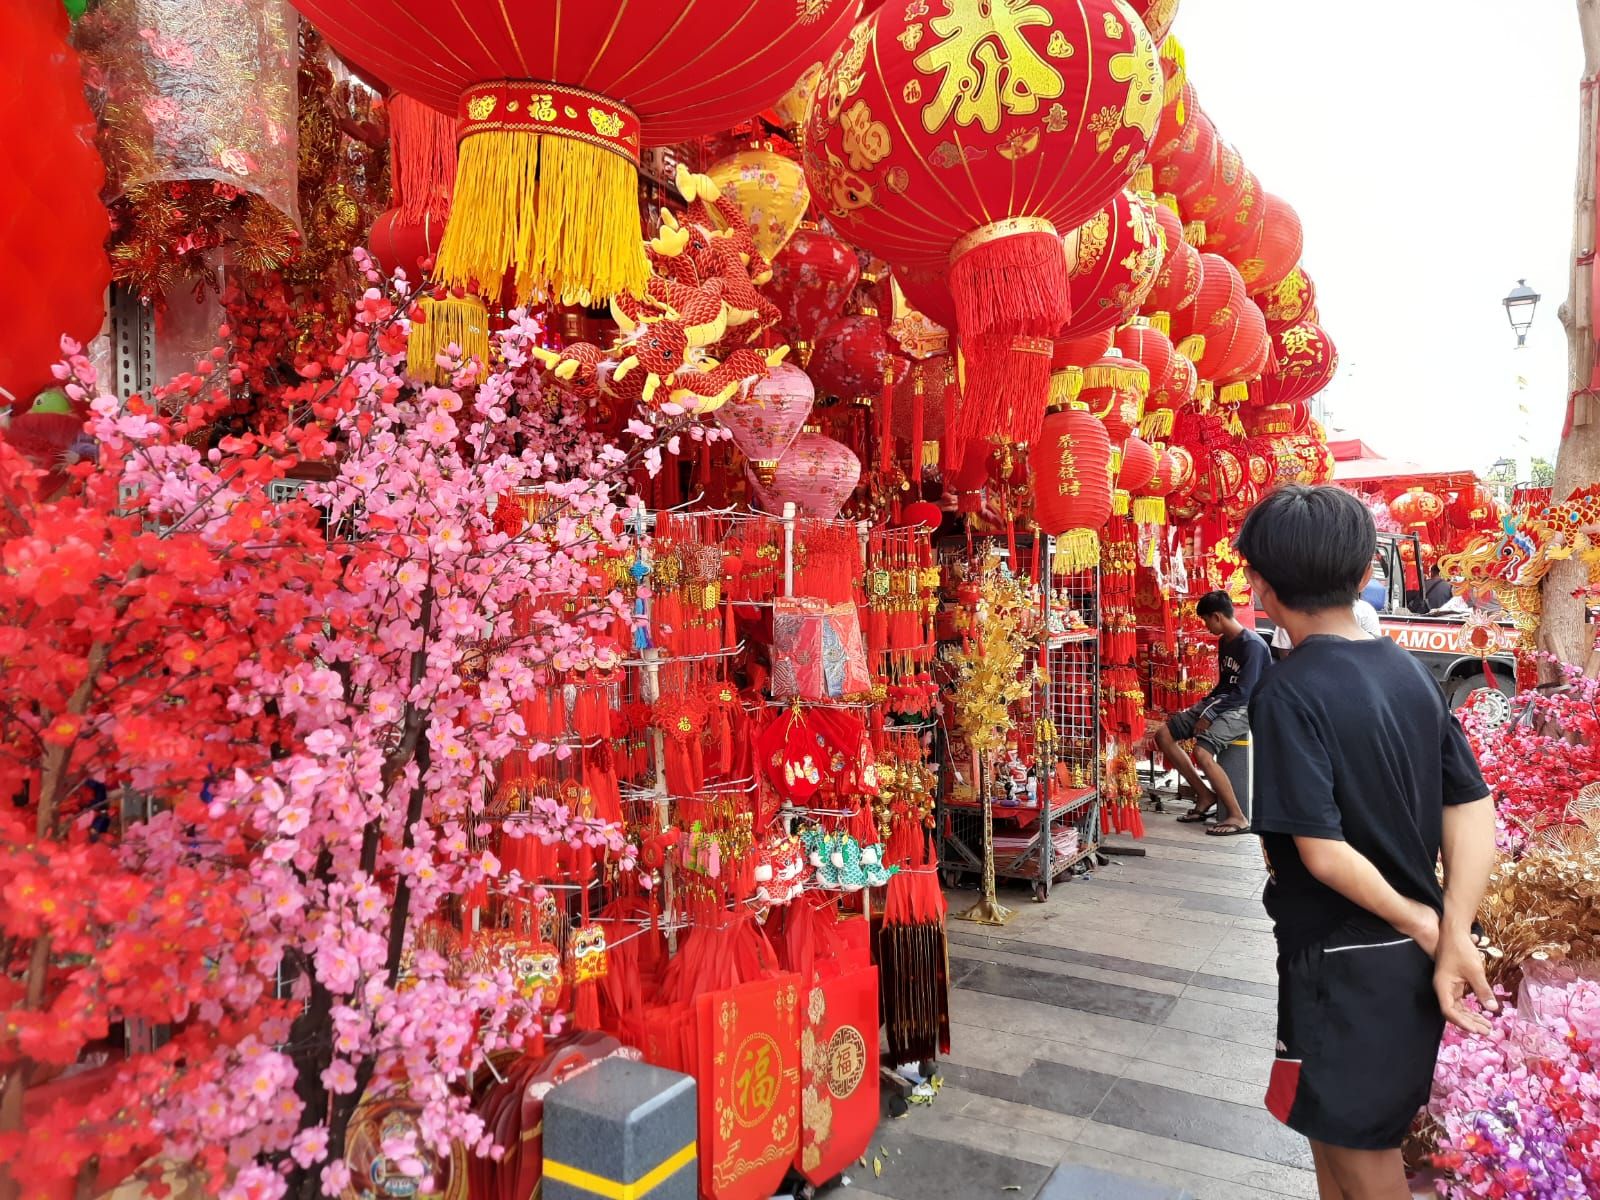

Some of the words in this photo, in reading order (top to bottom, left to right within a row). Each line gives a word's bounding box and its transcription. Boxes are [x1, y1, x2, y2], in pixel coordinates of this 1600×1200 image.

[527, 94, 557, 121] 福
[677, 716, 691, 732] 福
[836, 1047, 853, 1077] 福
[736, 1042, 776, 1116] 福
